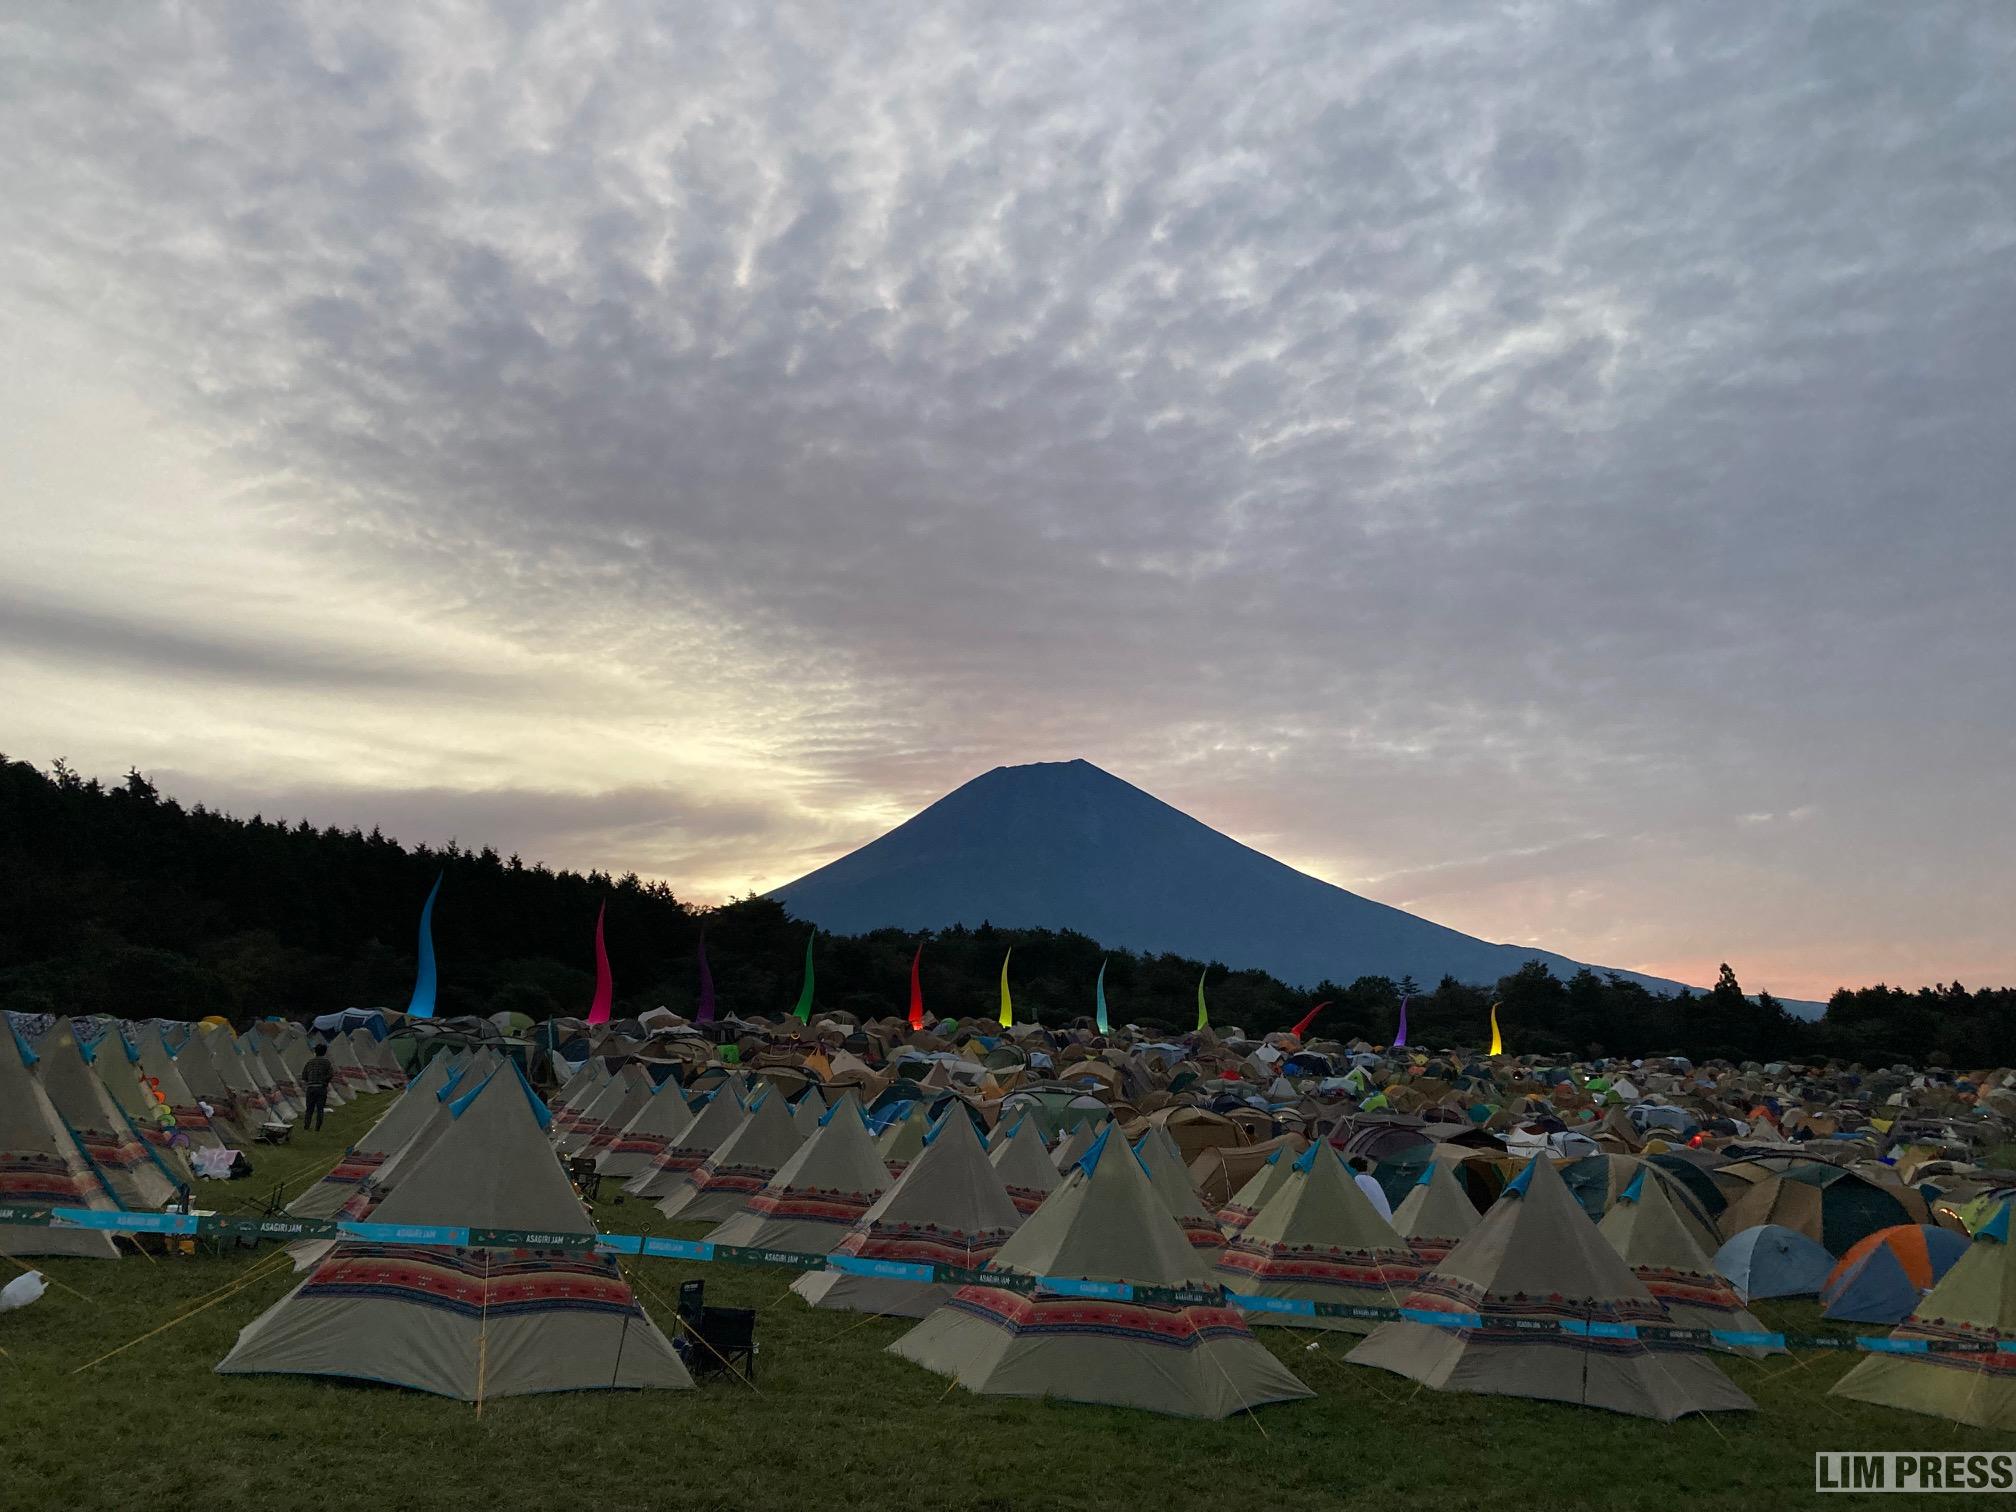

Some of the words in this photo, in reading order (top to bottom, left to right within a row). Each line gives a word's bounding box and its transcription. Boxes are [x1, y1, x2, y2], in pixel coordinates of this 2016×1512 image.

[260, 1222, 288, 1232] ASAGIRI
[288, 1223, 303, 1233] JAM
[525, 1234, 550, 1244] ASAGIRI
[550, 1235, 564, 1245] JAM
